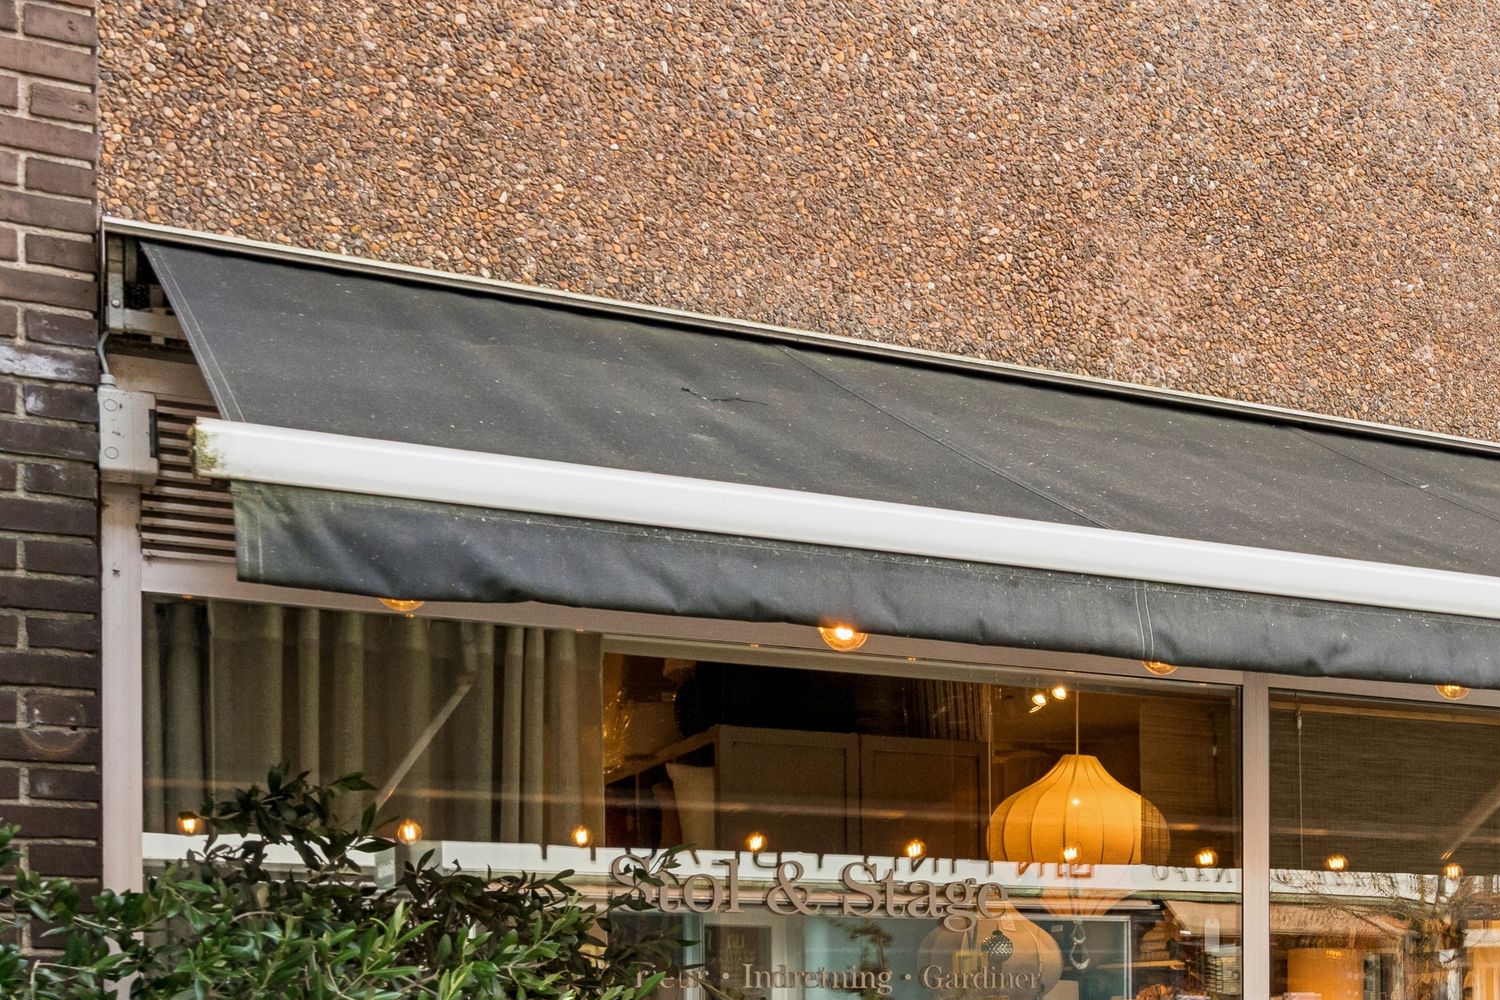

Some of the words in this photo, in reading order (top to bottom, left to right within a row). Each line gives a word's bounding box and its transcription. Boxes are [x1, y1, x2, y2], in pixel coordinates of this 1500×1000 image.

[611, 854, 745, 914] Stol
[766, 860, 821, 915] &
[842, 861, 1009, 932] Stage
[742, 962, 893, 995] Indretning
[922, 964, 1042, 990] Gardiner
